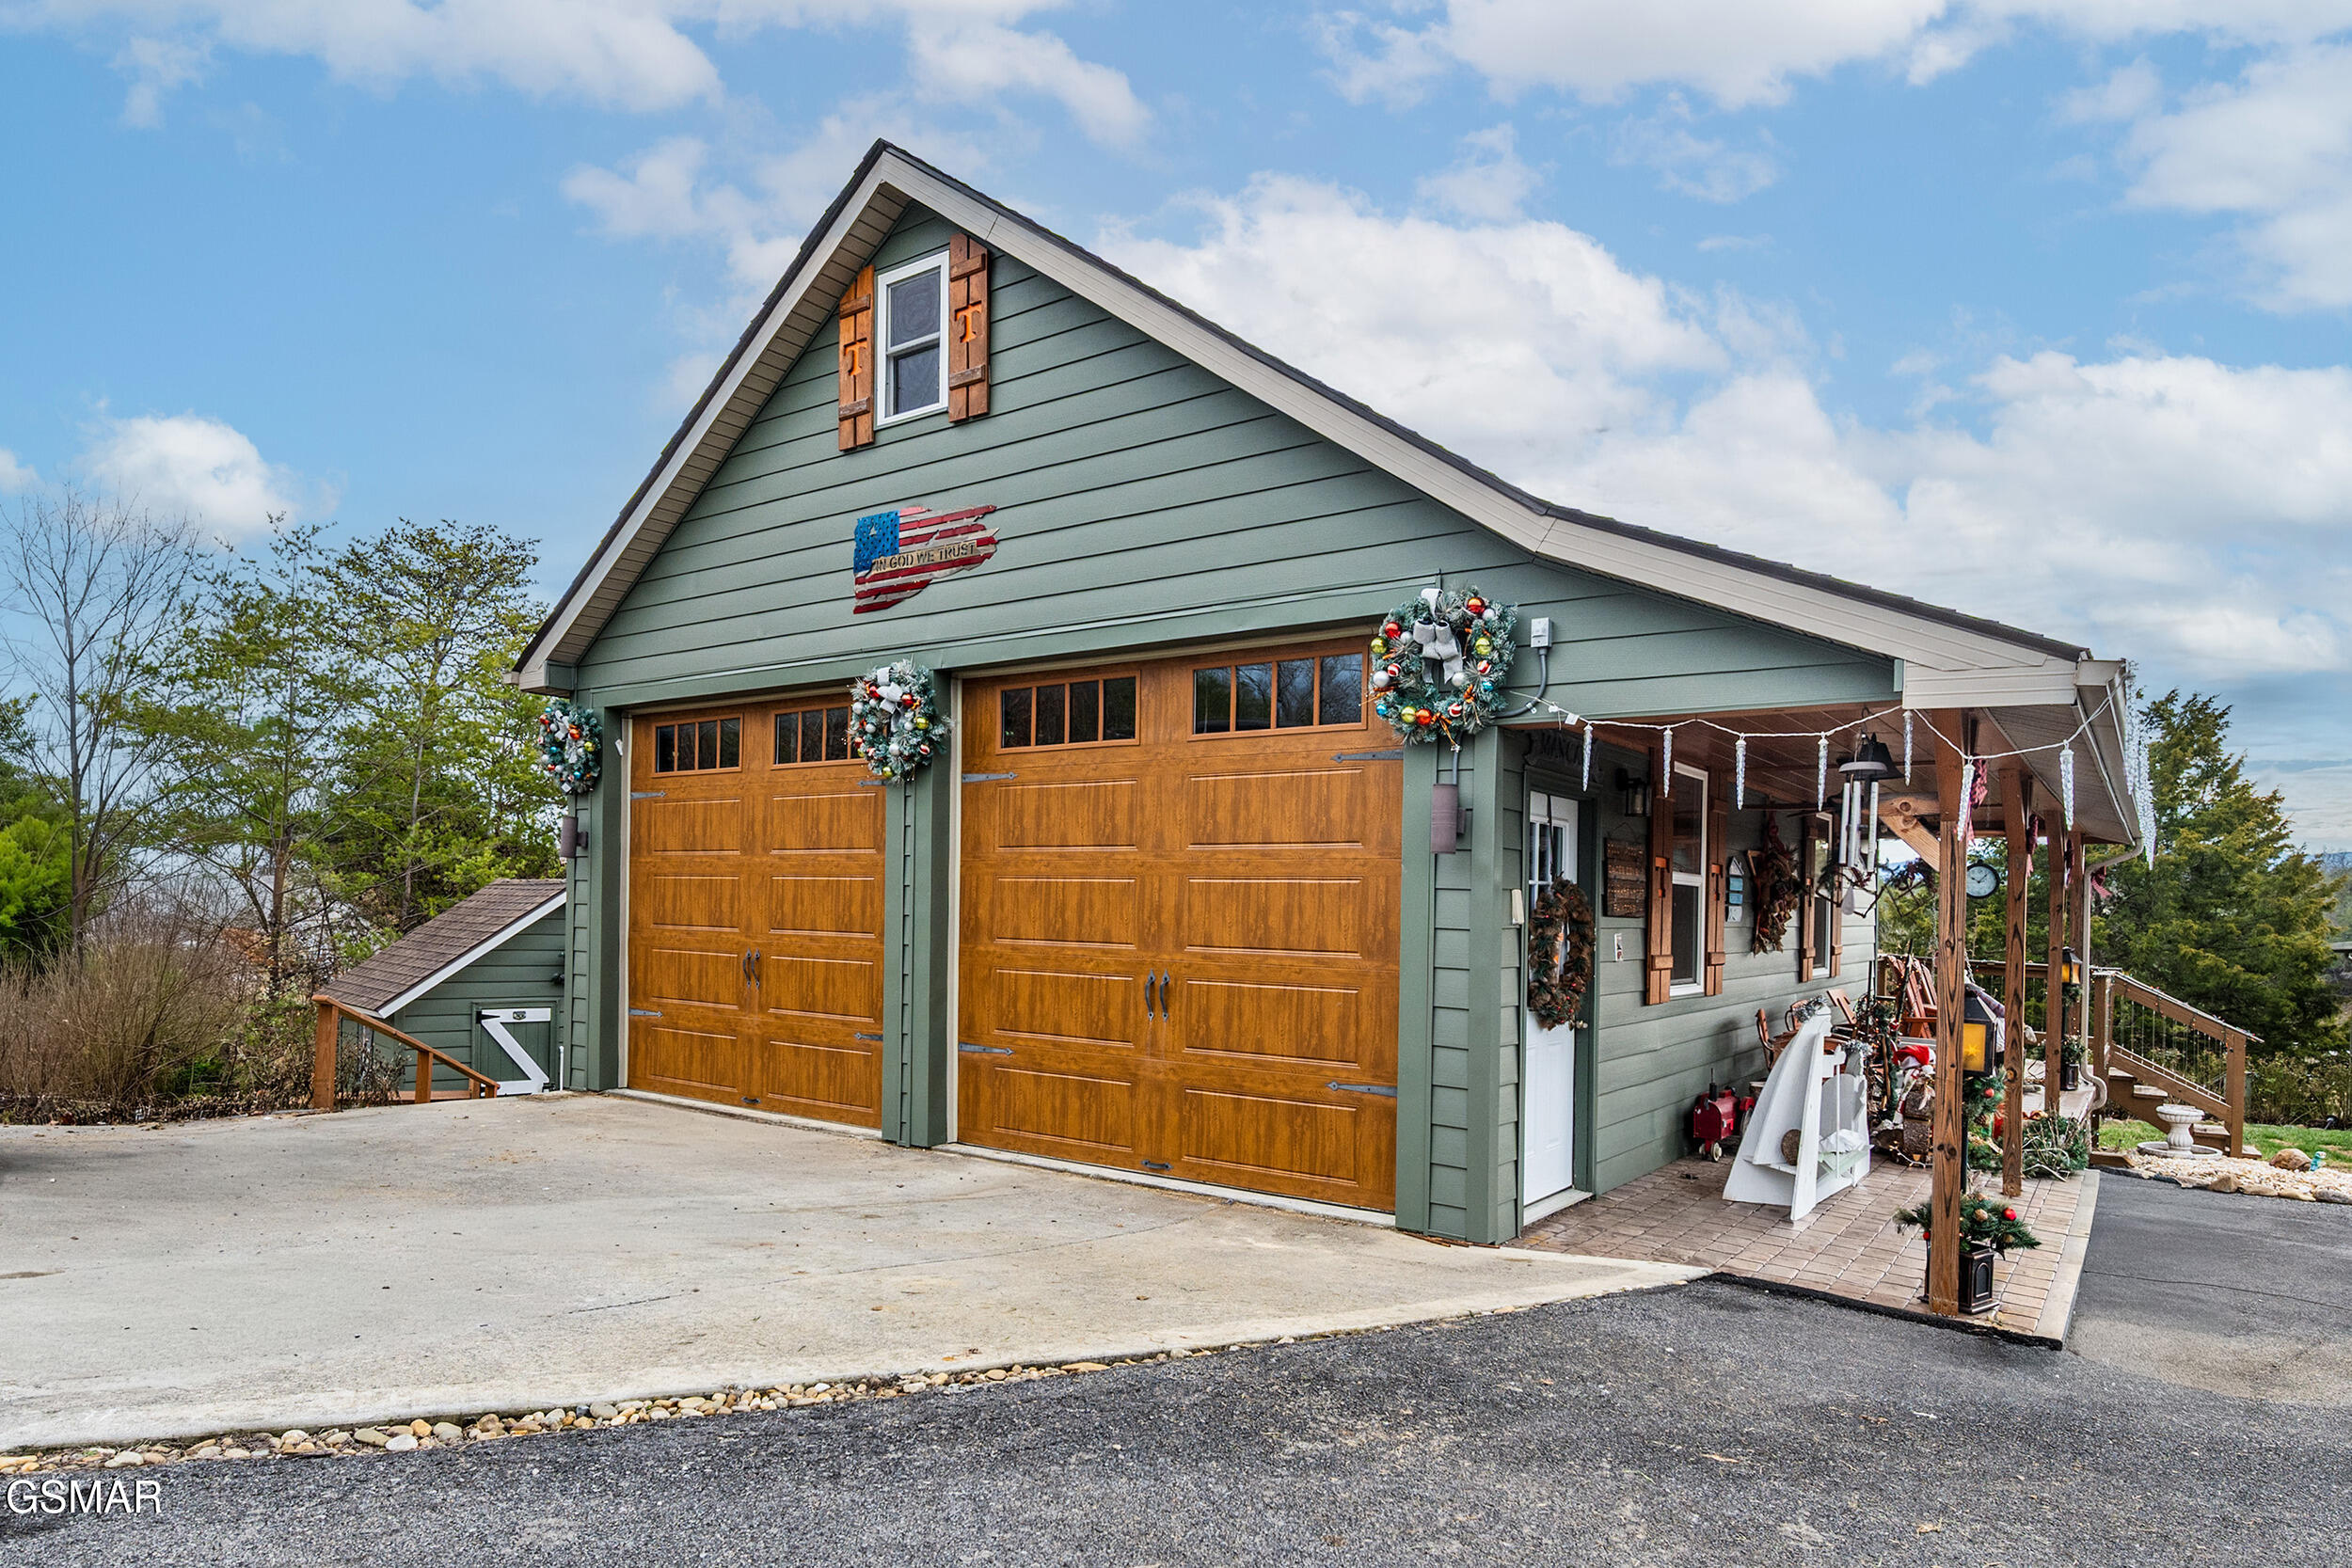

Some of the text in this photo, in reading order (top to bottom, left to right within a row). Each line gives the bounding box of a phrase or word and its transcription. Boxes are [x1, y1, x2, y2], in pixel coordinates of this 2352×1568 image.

[954, 300, 982, 343] T
[844, 338, 867, 376] T
[874, 542, 976, 572] IN GOD WE TRUST
